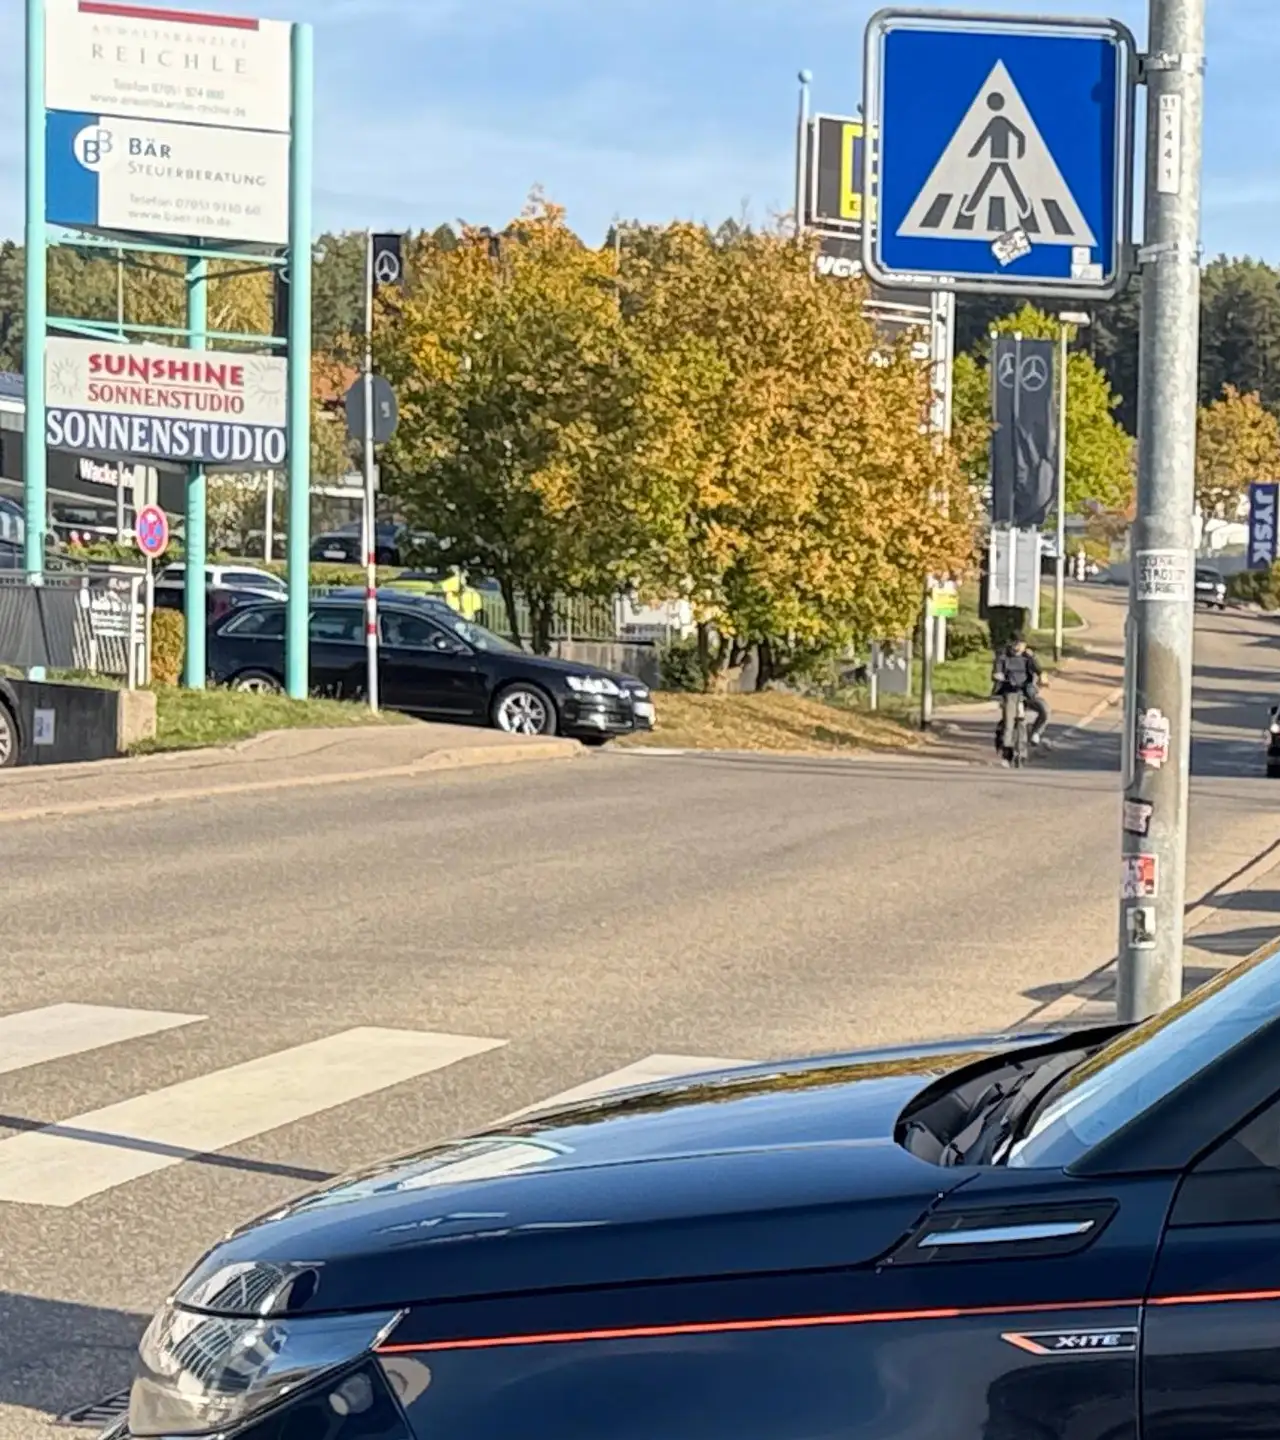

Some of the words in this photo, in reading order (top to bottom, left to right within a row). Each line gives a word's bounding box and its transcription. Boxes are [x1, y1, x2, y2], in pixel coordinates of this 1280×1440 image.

[91, 43, 248, 74] REICHLE
[128, 137, 172, 160] BÄR
[88, 354, 244, 389] SUNSHINE
[88, 383, 245, 414] SONNENSTUDIO
[47, 410, 287, 464] SONNENSTUDIO
[1252, 488, 1275, 569] JYSK
[1055, 1333, 1121, 1348] X-ITE
